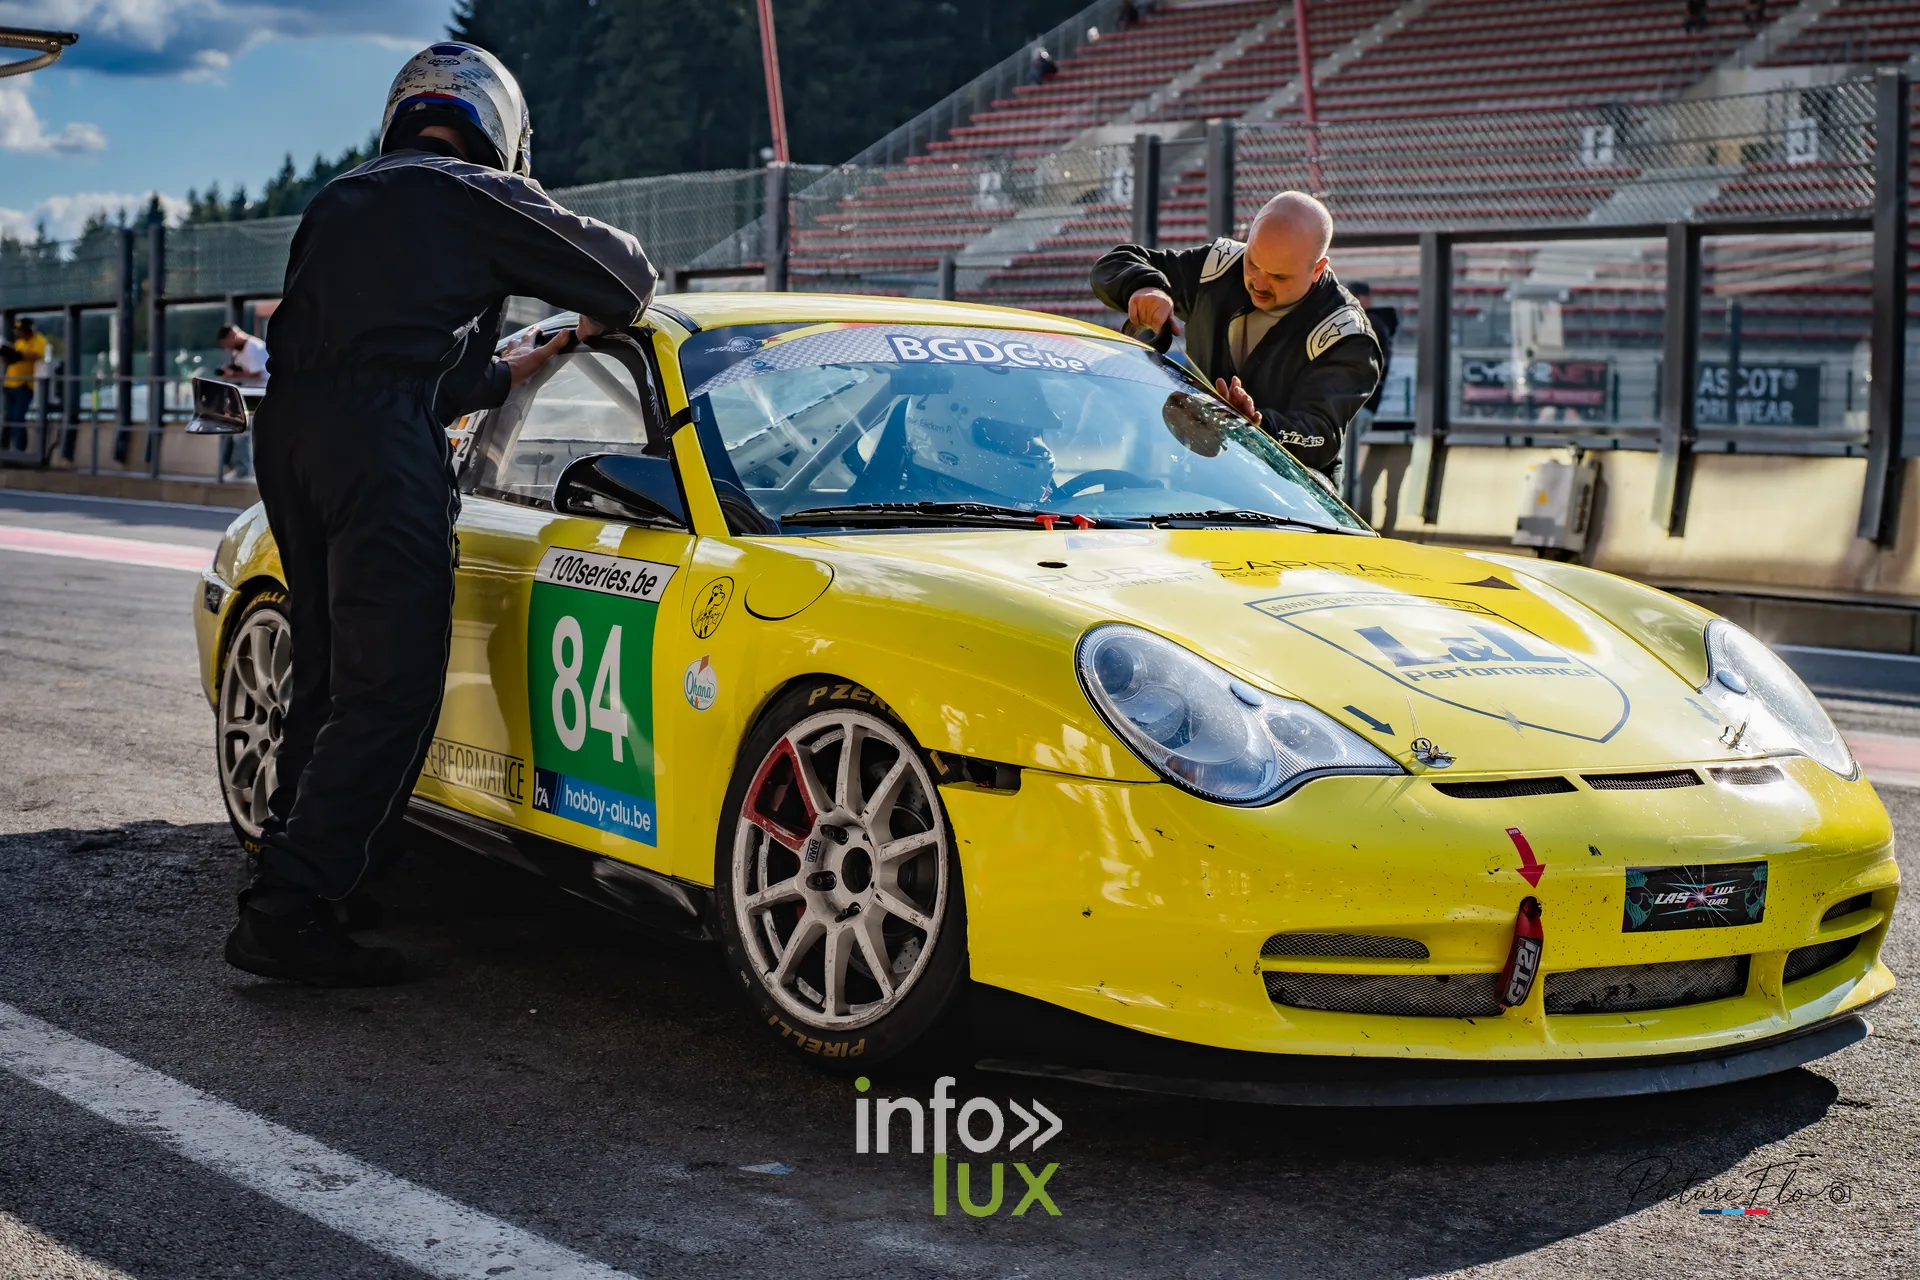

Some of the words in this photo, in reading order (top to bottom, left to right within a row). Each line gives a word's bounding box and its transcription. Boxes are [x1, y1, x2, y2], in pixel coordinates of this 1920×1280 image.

[892, 336, 1085, 372] BGDC.be
[1463, 360, 1606, 384] CYBRNET
[1698, 366, 1784, 398] ASCOT
[549, 554, 658, 596] 100series.be
[1201, 559, 1422, 577] CAPITAL
[1354, 625, 1573, 668] L&L
[686, 670, 712, 699] Ohana
[1401, 663, 1597, 682] Performance
[551, 614, 629, 764] 84
[565, 784, 651, 831] hobby-alu.be
[807, 839, 820, 863] BRAID
[1654, 892, 1691, 905] LAS
[767, 1015, 866, 1058] PIRELLI
